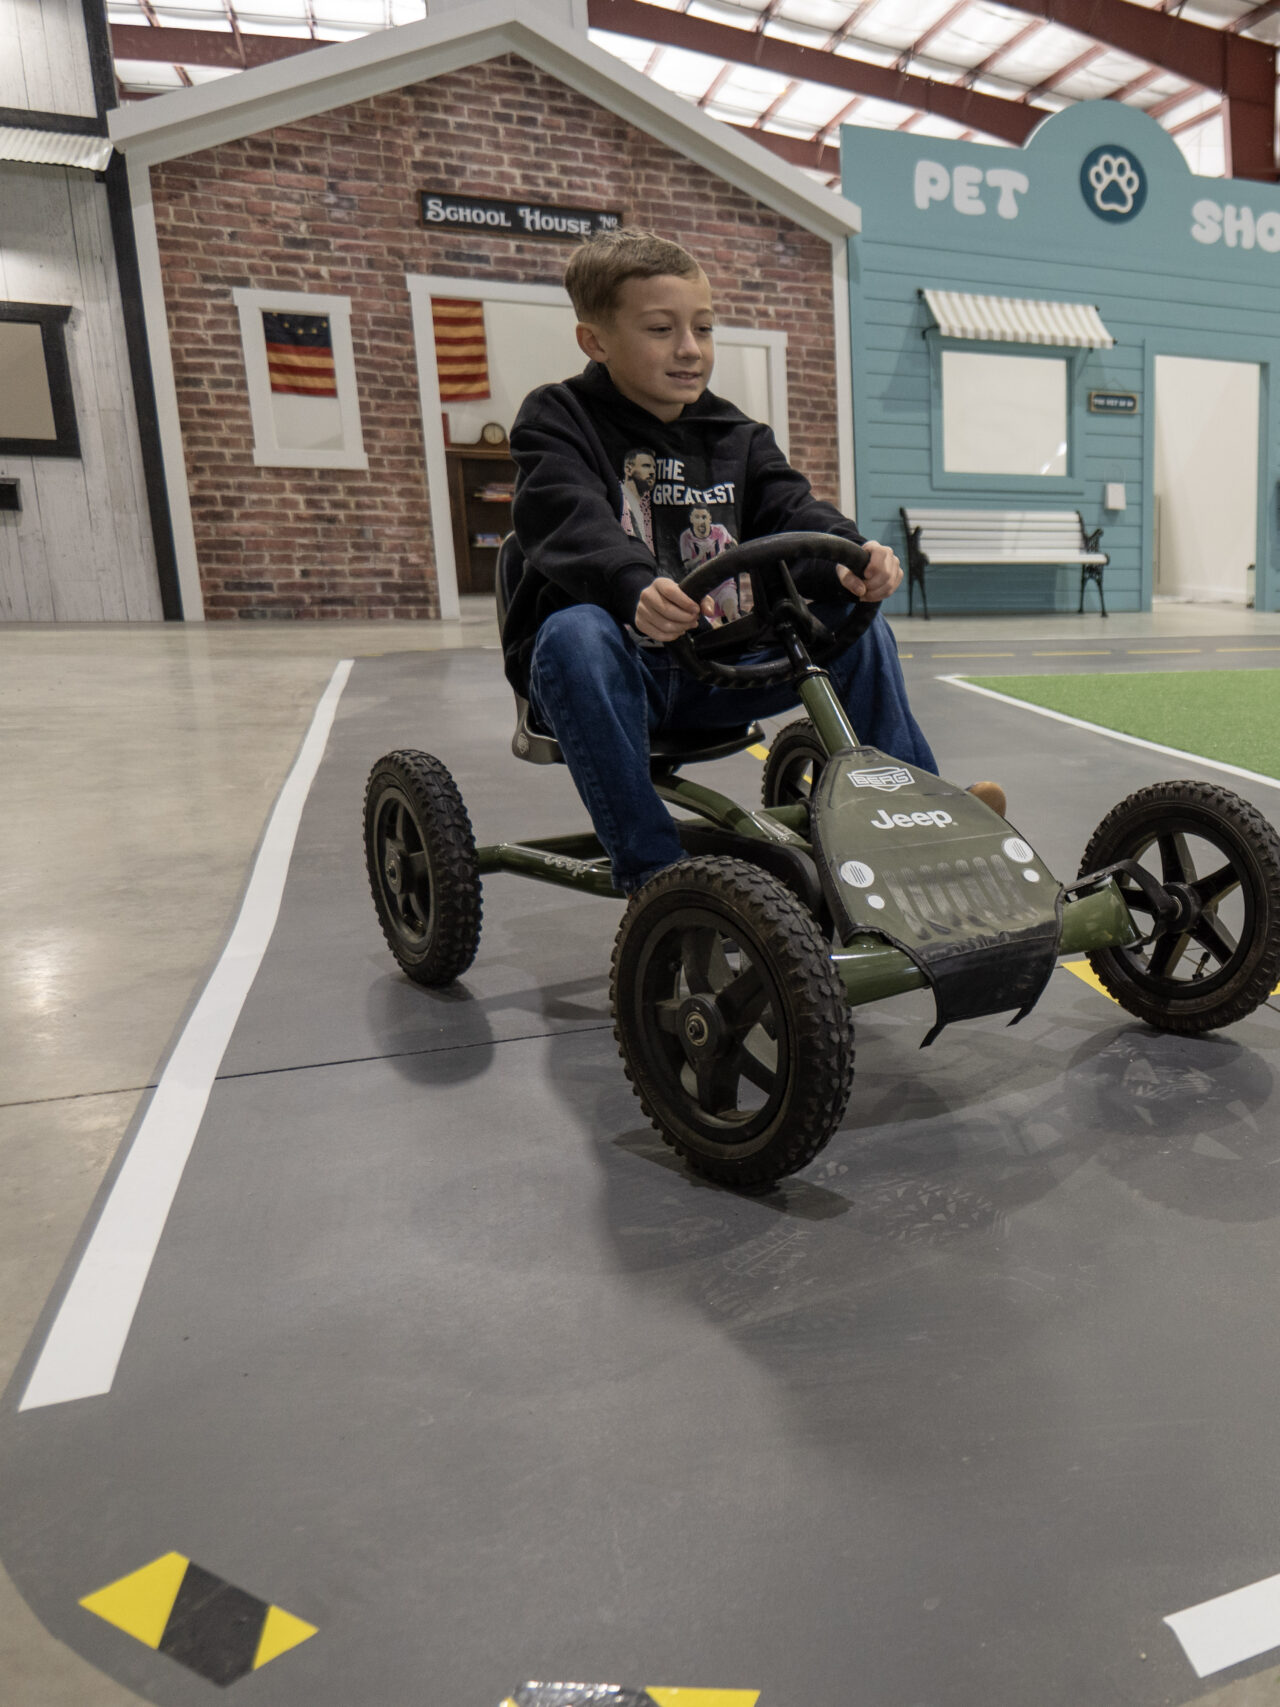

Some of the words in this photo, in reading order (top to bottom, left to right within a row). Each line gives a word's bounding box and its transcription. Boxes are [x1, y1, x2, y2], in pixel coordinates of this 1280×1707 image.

[914, 159, 1030, 220] PET
[426, 199, 512, 227] SCHOOL
[518, 206, 592, 235] HOUSE
[656, 458, 686, 482] THE
[652, 483, 736, 506] GREATEST
[851, 771, 910, 786] BERG
[869, 809, 954, 830] Jeep
